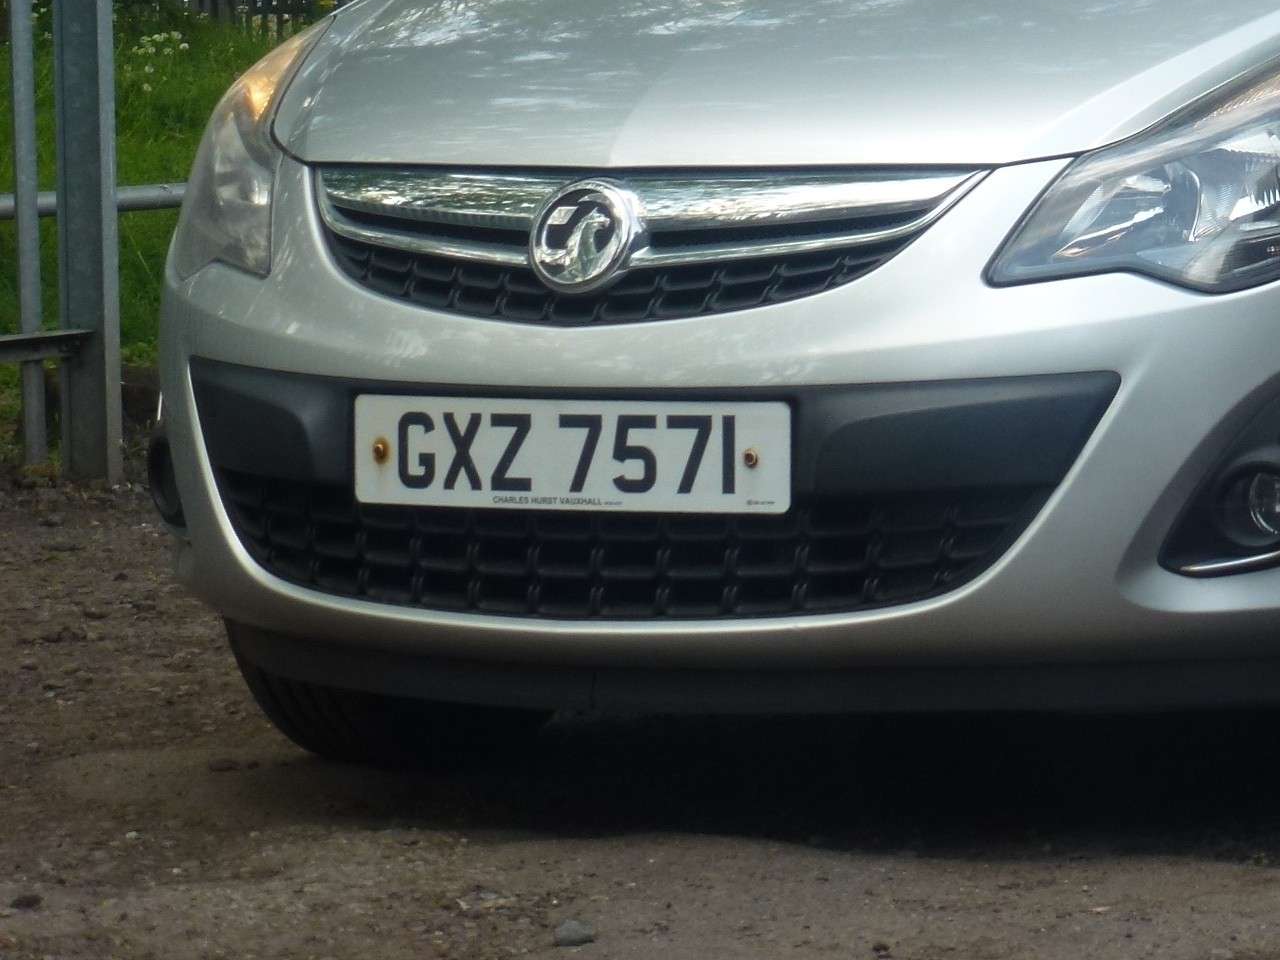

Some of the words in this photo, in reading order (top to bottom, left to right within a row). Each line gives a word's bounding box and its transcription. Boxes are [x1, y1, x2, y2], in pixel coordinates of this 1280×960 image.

[399, 411, 532, 492] GXZ
[558, 414, 736, 494] 7571
[492, 495, 529, 504] CHARLES
[531, 496, 558, 504] HURST
[559, 496, 602, 506] VAUXHALL
